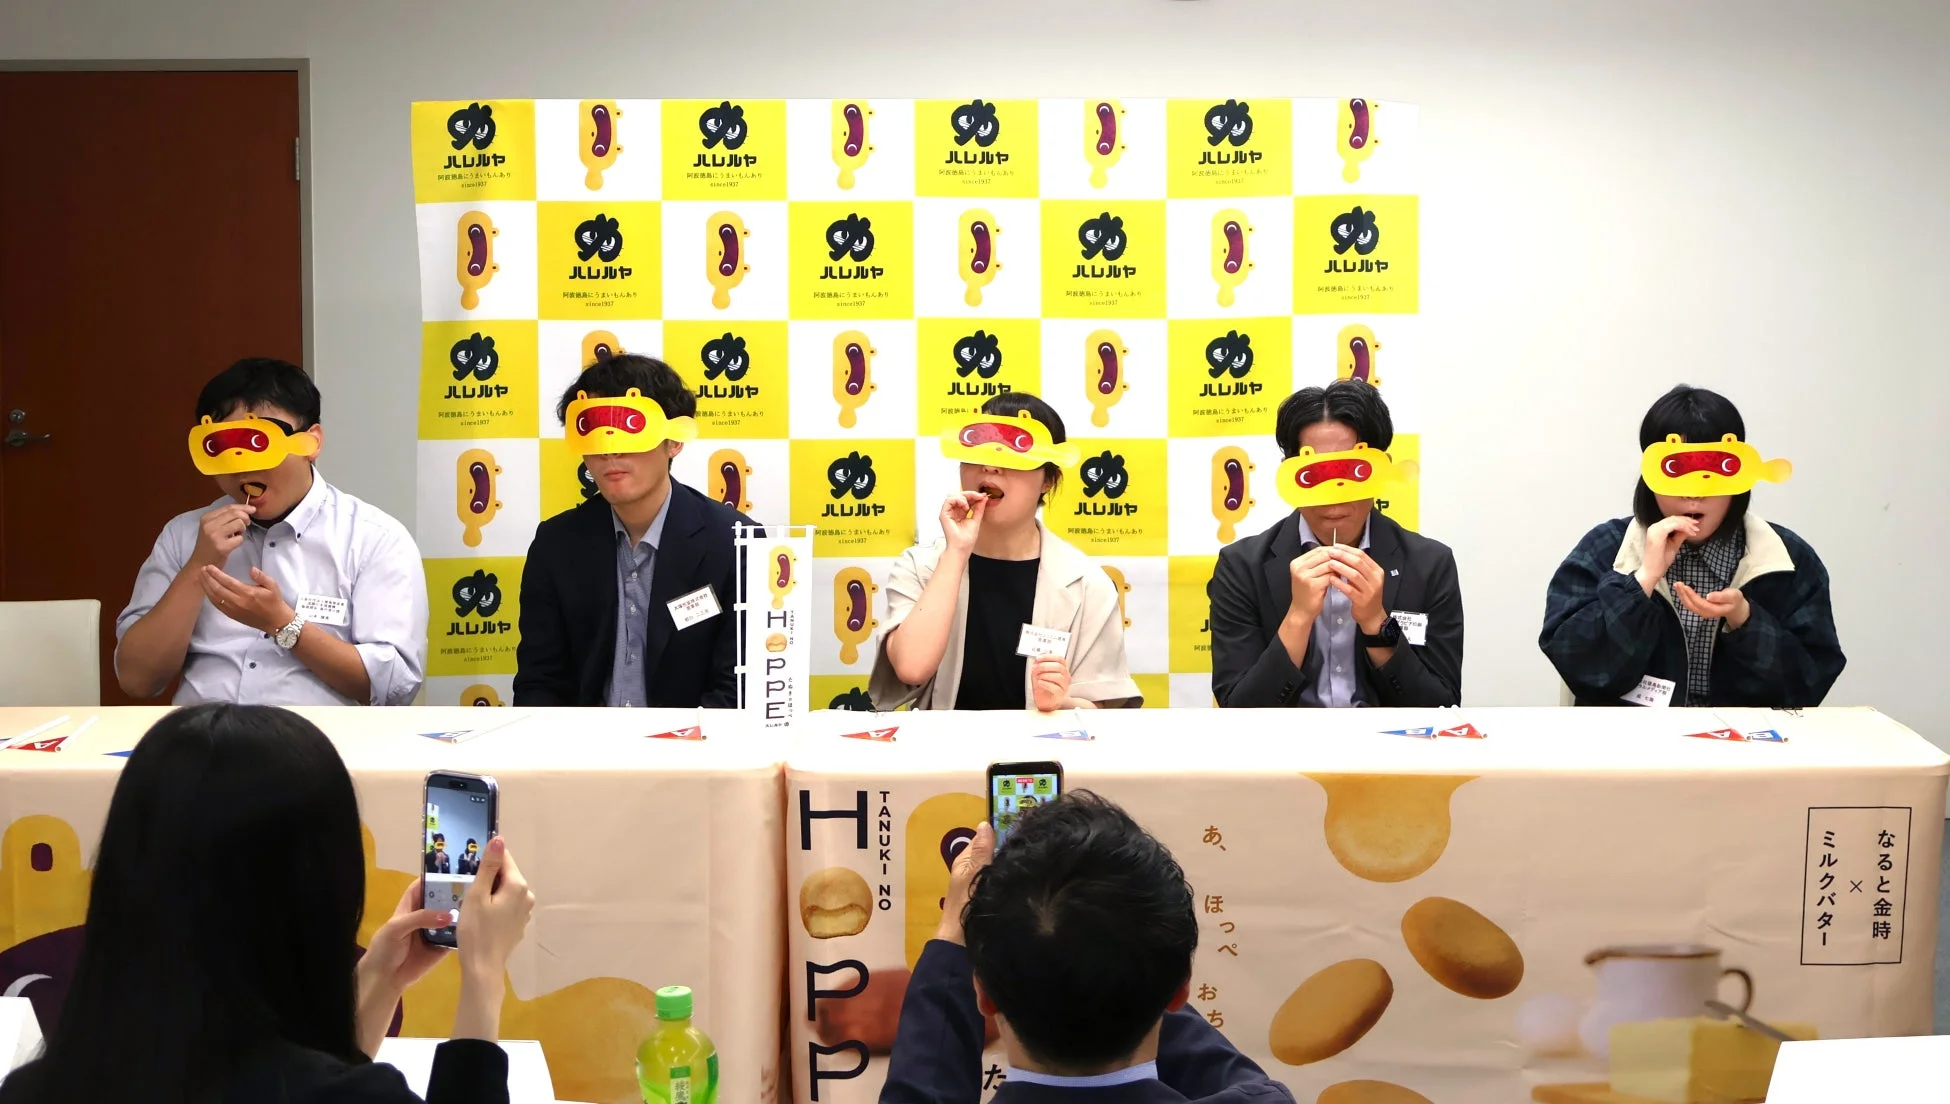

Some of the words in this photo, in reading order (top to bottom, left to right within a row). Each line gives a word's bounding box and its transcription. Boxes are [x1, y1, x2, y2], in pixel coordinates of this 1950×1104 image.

[444, 153, 506, 169] ハレルヤ
[693, 153, 758, 168] ハレルヤ
[945, 150, 1009, 165] ハレルヤ
[1198, 150, 1262, 165] ハレルヤ
[569, 265, 632, 280] ハレルヤ
[820, 265, 883, 280] ハレルヤ
[1072, 264, 1136, 279] ハレルヤ
[1324, 259, 1388, 273] ハレルヤ
[444, 384, 508, 399] ハレルヤ
[695, 384, 759, 398] ハレルヤ
[947, 382, 1011, 396] ハレルヤ
[1199, 381, 1263, 397] ハレルヤ
[695, 410, 764, 418] 波徳島にうまいもんあり
[821, 503, 885, 517] ハレルヤ
[1074, 502, 1138, 516] ハレルヤ
[1067, 527, 1143, 535] 阿波徳島にうまいもんあり
[446, 621, 511, 636] ハレルヤ
[878, 790, 892, 876] TANUKI
[1816, 830, 1839, 947] ミルクバター
[1872, 829, 1896, 941] なると金時
[878, 884, 892, 911] NO
[1204, 894, 1239, 957] ほっぺ
